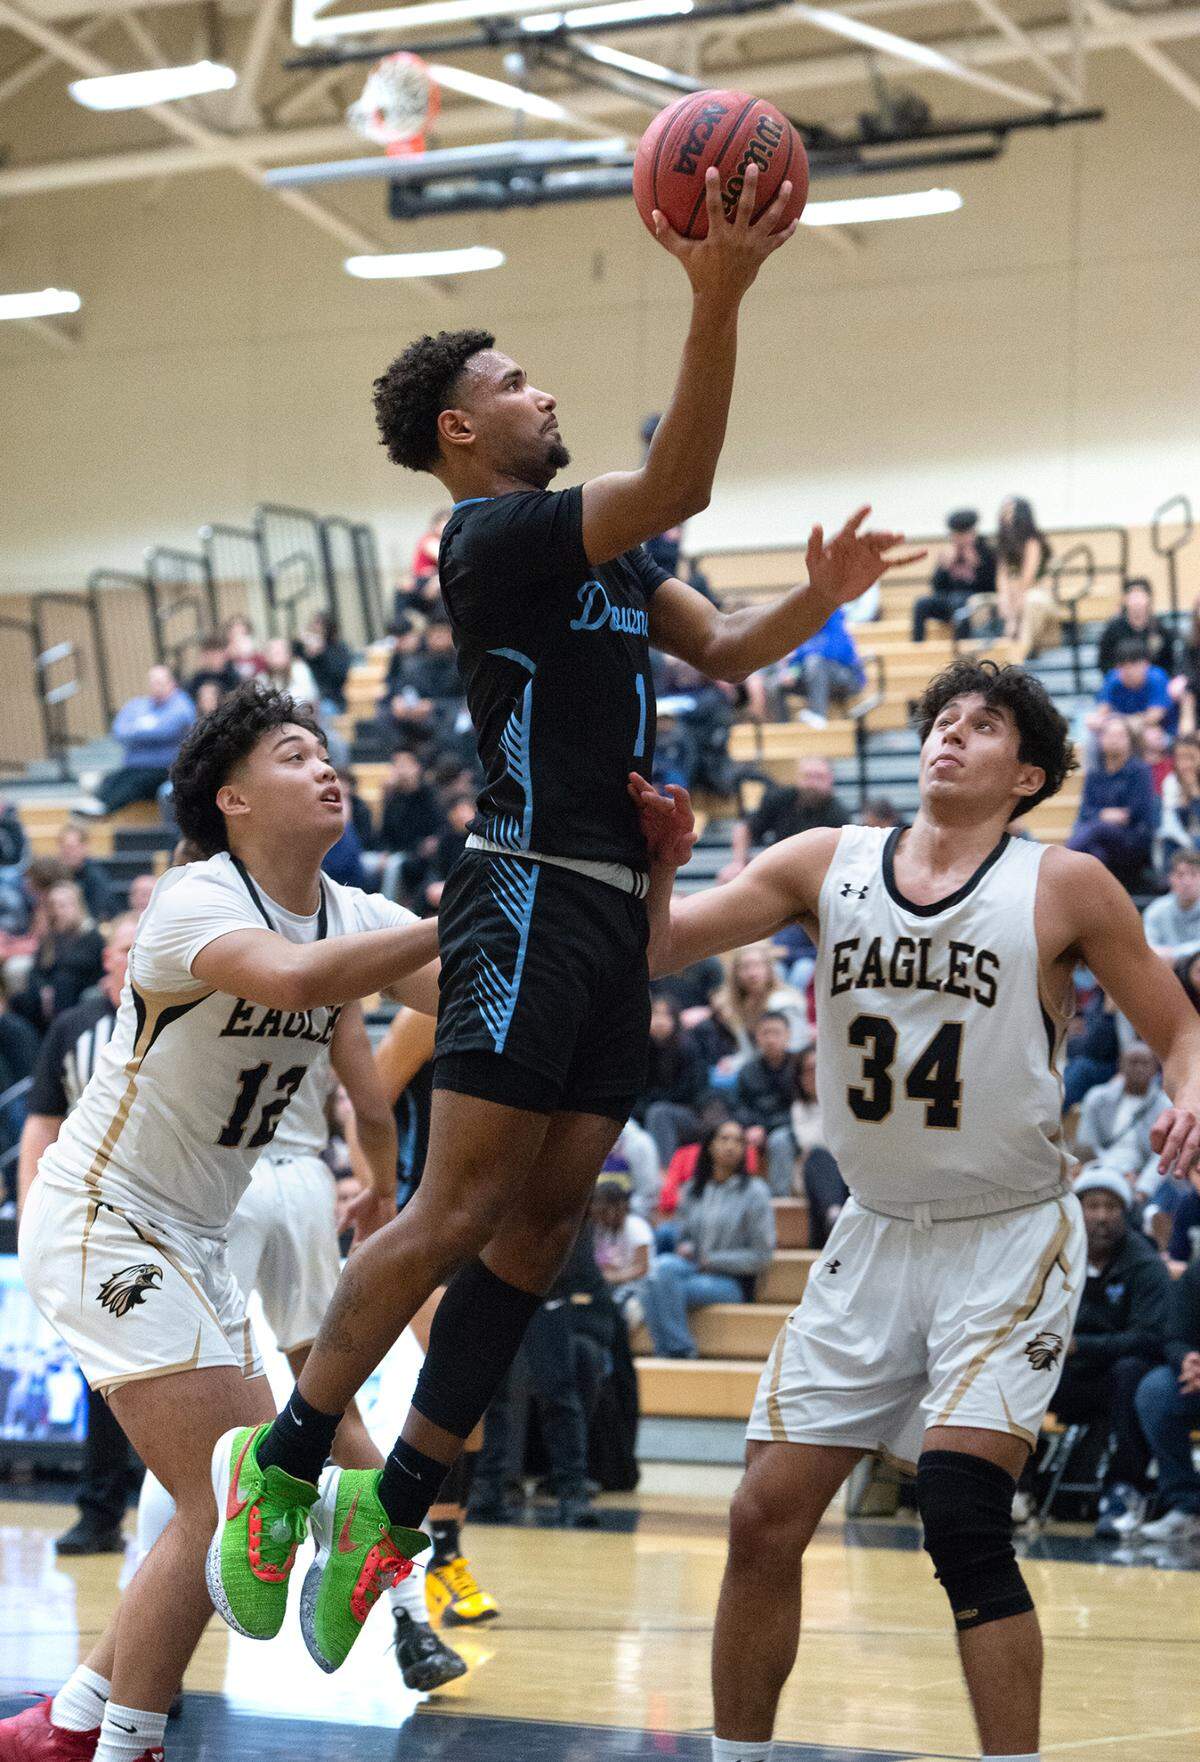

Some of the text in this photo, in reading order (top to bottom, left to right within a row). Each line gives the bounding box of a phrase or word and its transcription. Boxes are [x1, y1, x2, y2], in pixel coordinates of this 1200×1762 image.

[672, 102, 729, 176] NCAA
[633, 673, 647, 758] 1
[831, 936, 1000, 1008] EAGLES
[216, 1060, 308, 1149] 12
[847, 1012, 965, 1131] 34
